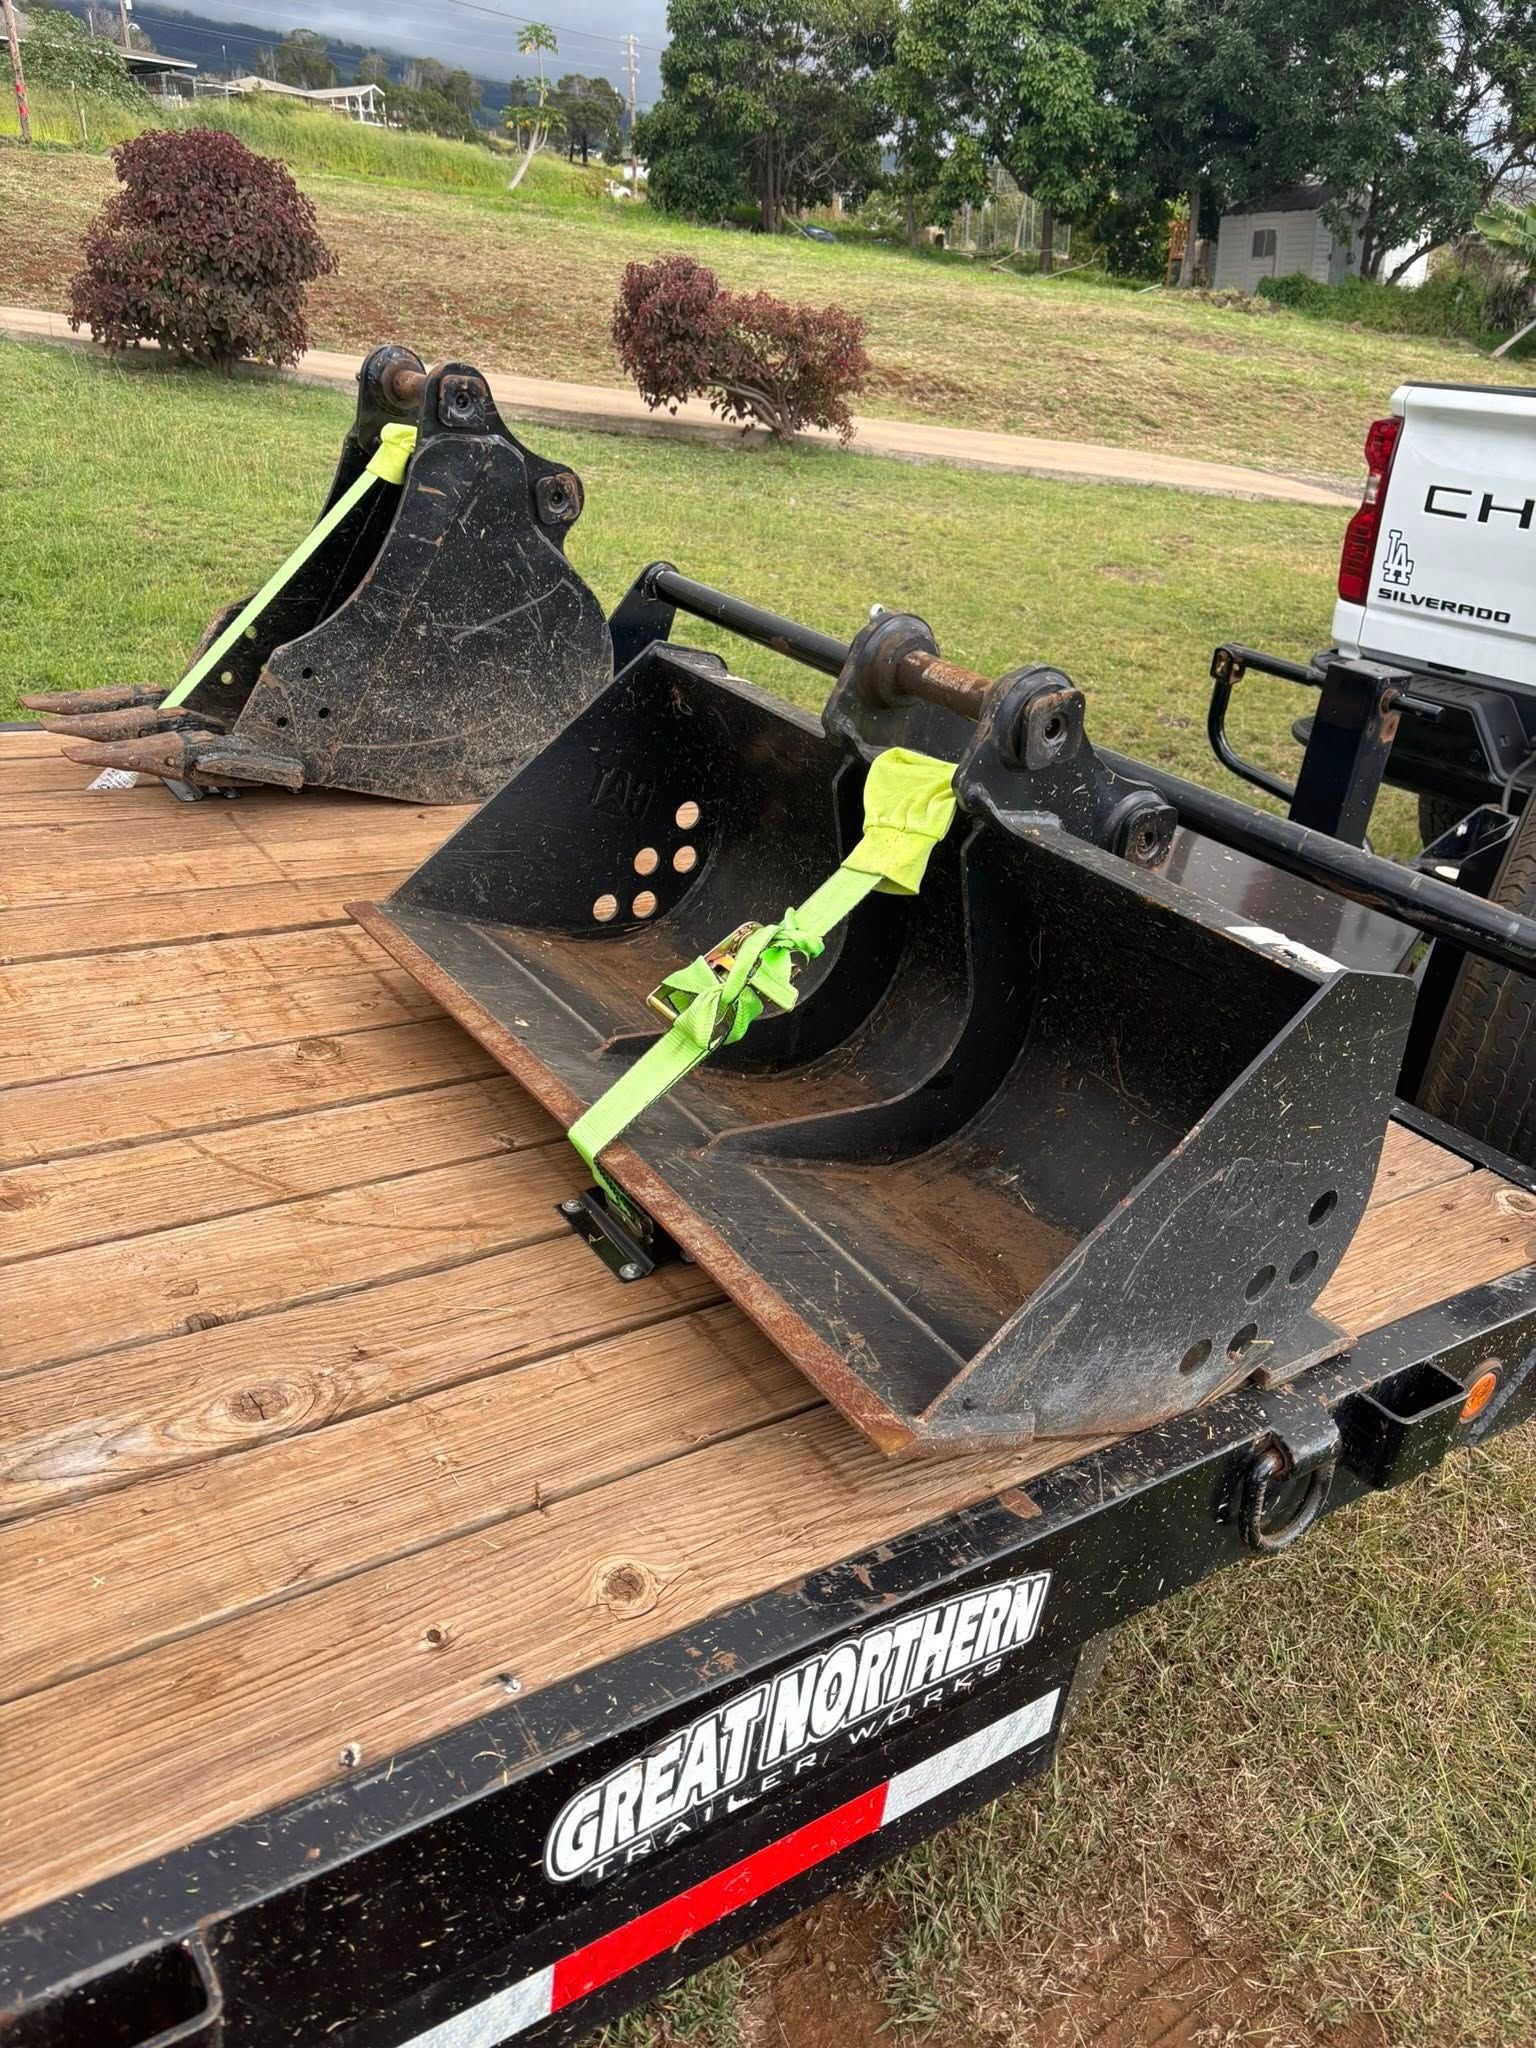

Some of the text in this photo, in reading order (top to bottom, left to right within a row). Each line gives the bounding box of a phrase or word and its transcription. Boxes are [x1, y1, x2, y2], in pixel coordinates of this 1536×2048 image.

[1378, 588, 1511, 624] SILVERADO
[1383, 529, 1415, 587] LA
[553, 1577, 1044, 1874] GREAT NORTHERN
[588, 1658, 1002, 1879] TRAILER WORKS
